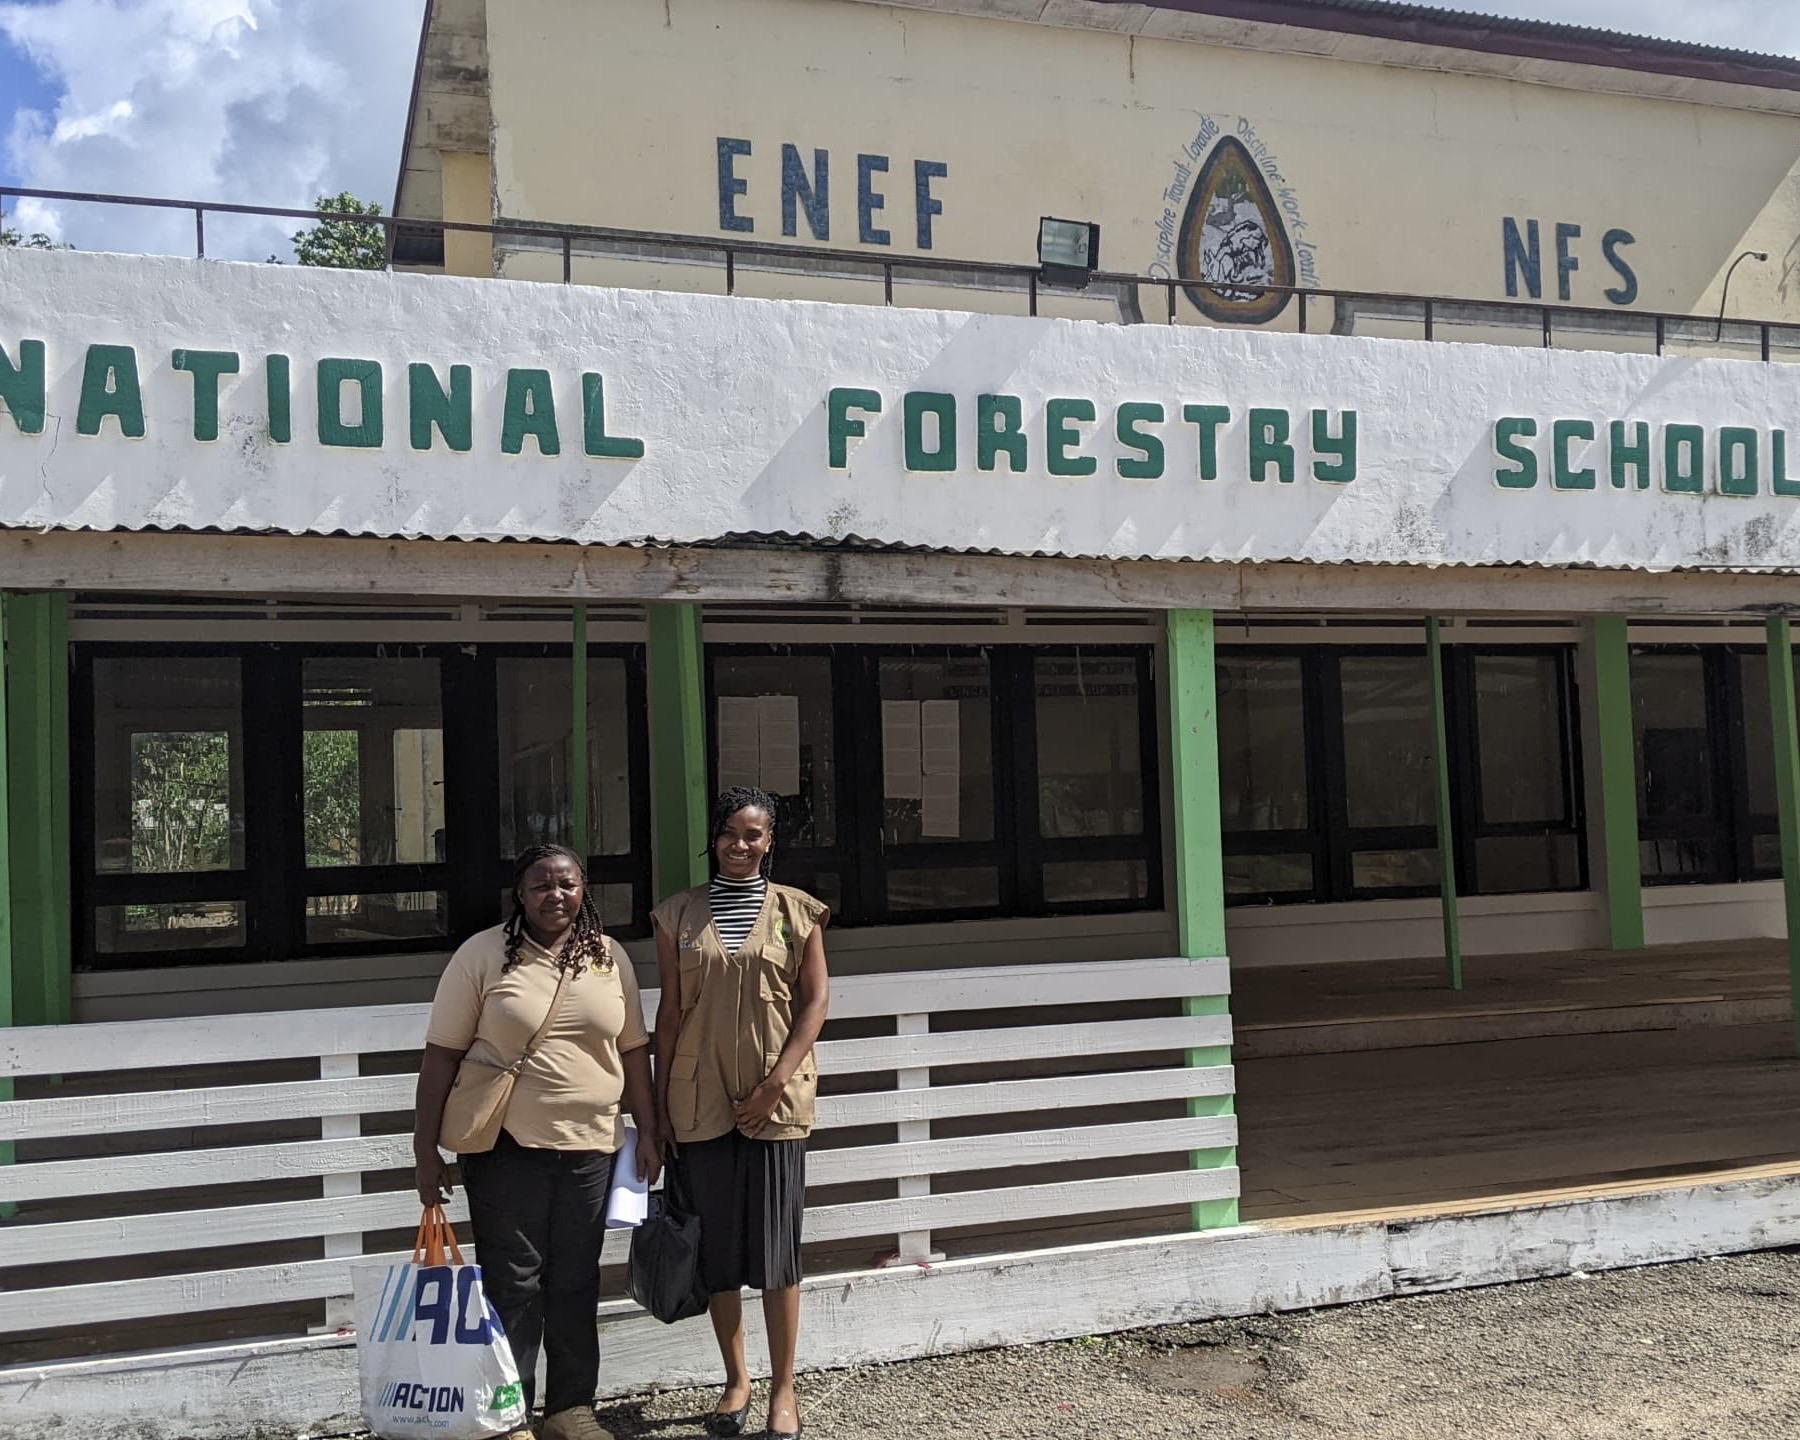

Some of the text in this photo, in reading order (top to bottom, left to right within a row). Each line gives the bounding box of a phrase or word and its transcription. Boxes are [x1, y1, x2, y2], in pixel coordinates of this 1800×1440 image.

[717, 137, 947, 249] ENEF
[1237, 115, 1281, 182] Discipline
[1502, 216, 1639, 305] NFS
[0, 338, 1800, 497] NATIONAL FORESTRY SCHOOL
